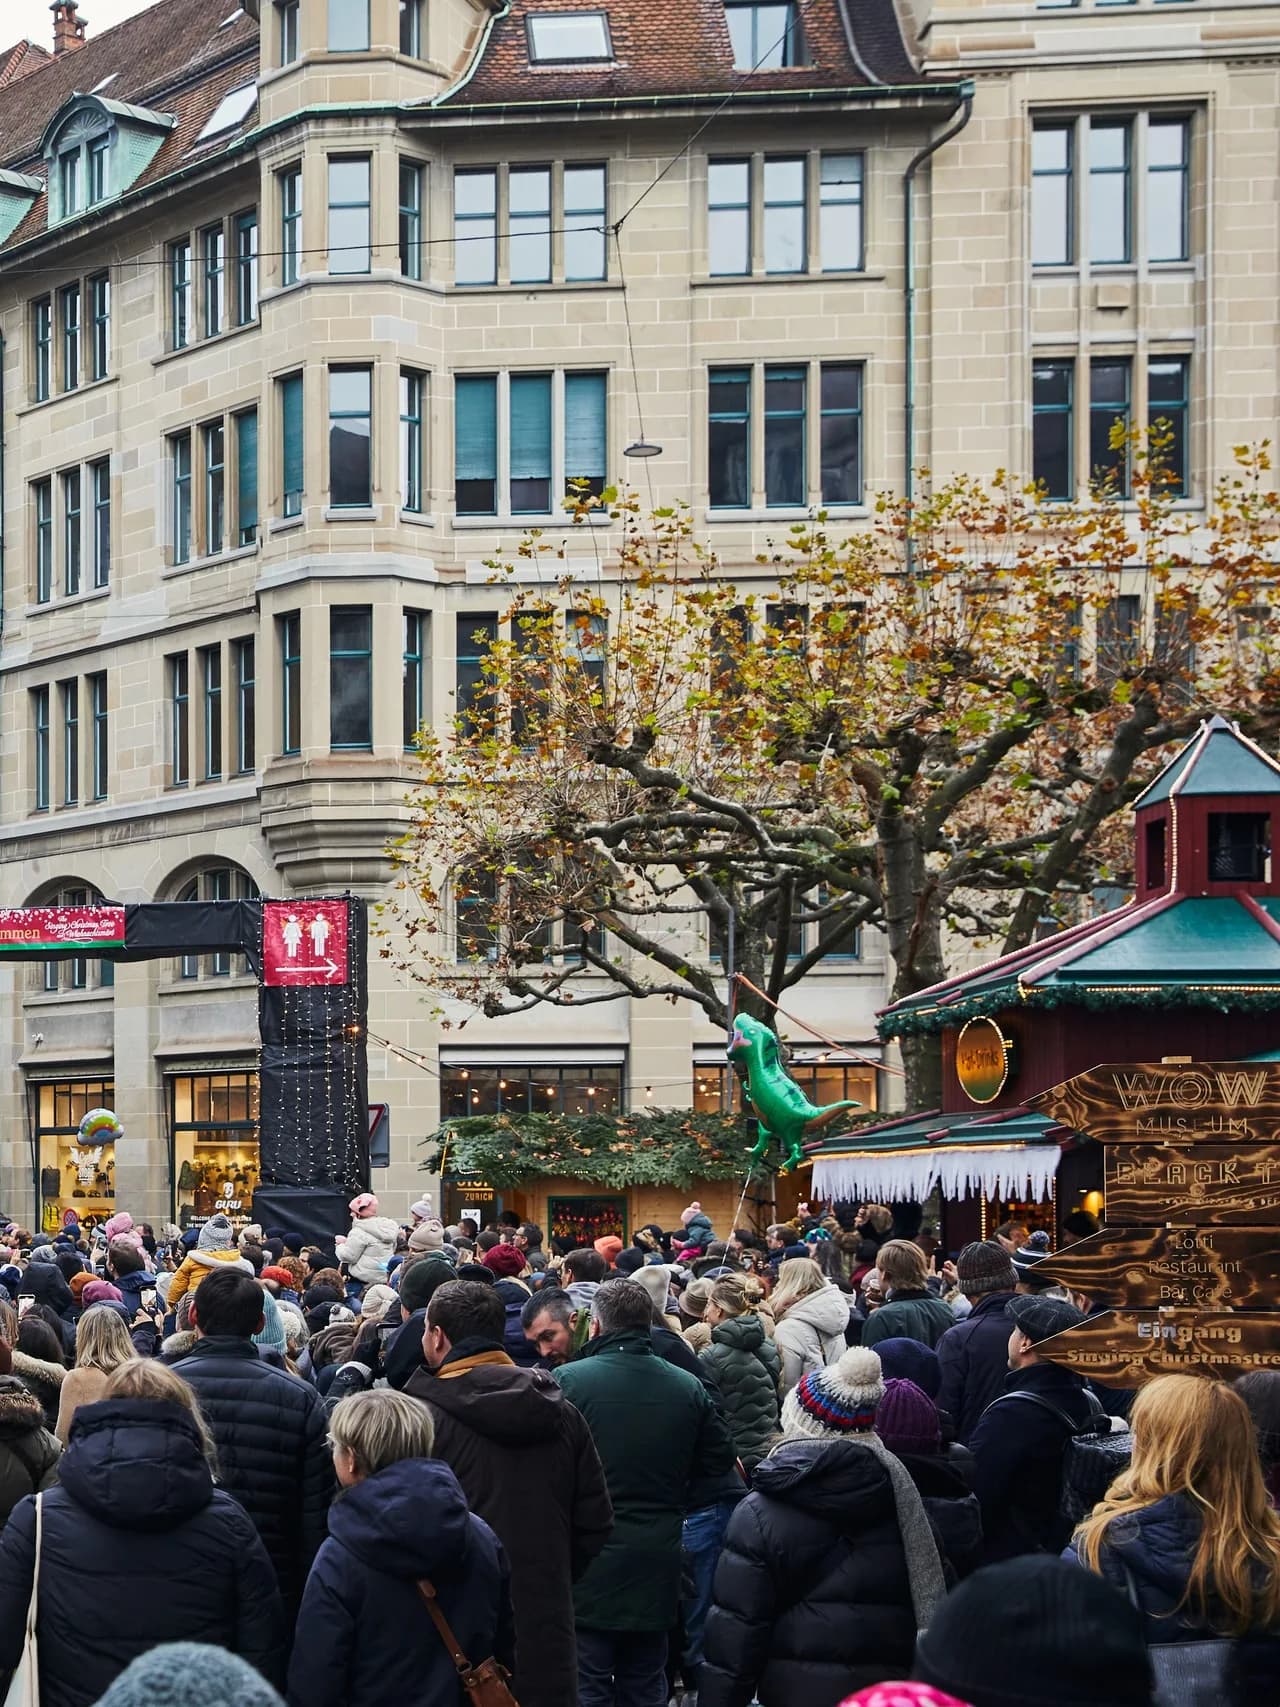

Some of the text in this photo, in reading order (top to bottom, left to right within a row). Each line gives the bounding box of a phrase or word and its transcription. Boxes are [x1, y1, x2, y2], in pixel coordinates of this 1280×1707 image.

[1112, 1071, 1268, 1112] WOW
[1136, 1115, 1248, 1136] MUSEUM
[1117, 1161, 1241, 1185] BLACK
[465, 1192, 493, 1201] ZURICH
[215, 1200, 242, 1209] GURU
[1175, 1235, 1213, 1249] Lotti
[1149, 1260, 1242, 1274] Restaurant
[1160, 1286, 1188, 1299] Bar
[1137, 1322, 1242, 1344] Eingang
[1067, 1350, 1144, 1365] Singing
